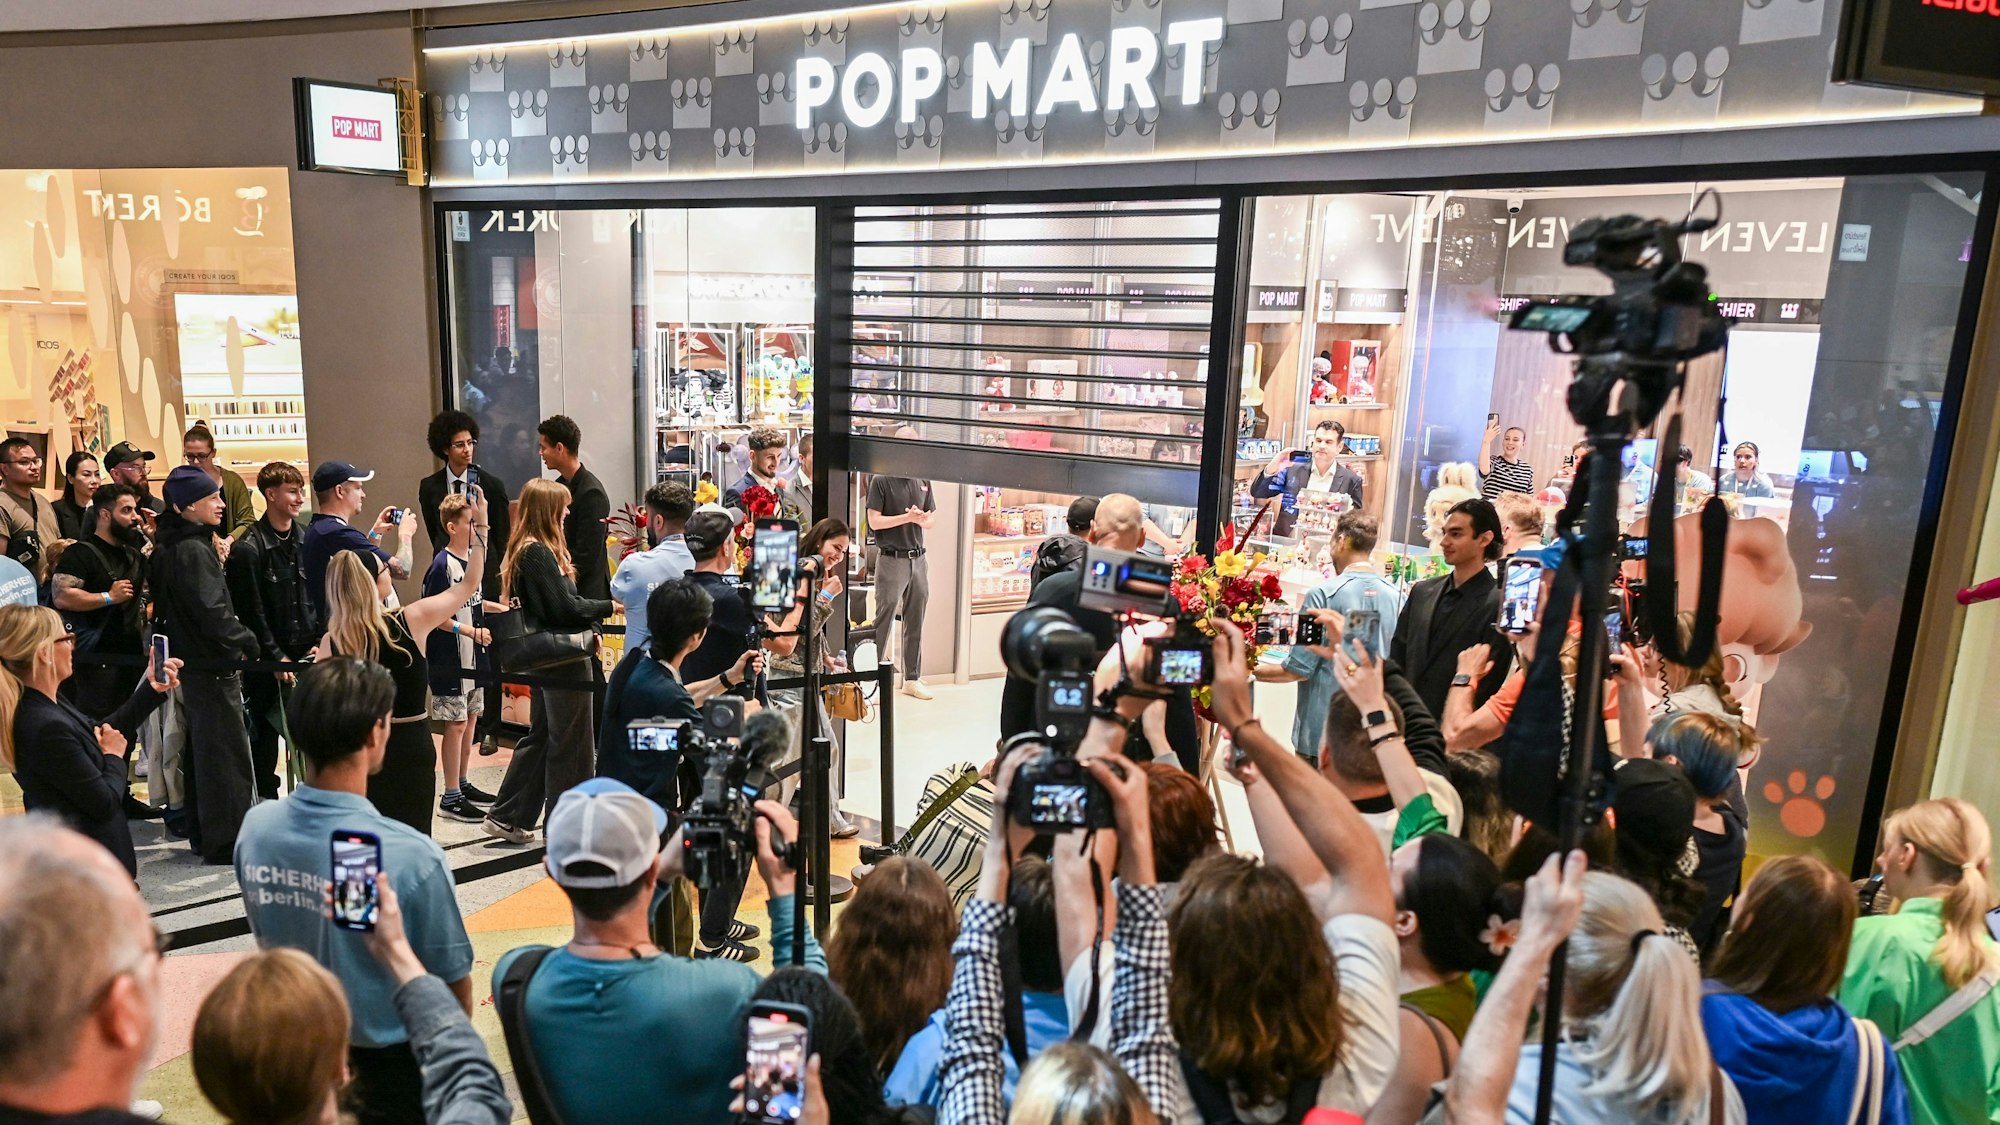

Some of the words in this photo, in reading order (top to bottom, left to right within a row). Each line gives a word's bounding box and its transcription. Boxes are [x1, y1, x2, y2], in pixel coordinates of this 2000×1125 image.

[796, 47, 943, 129] POP
[971, 17, 1223, 119] MART
[334, 119, 353, 136] POP
[354, 120, 380, 139] MART
[168, 272, 195, 280] CREATE
[197, 272, 217, 280] YOUR
[1259, 291, 1276, 306] POP
[1277, 291, 1299, 306] MART
[1350, 294, 1367, 307] POP
[1367, 294, 1387, 307] MART
[37, 340, 60, 350] IQOS
